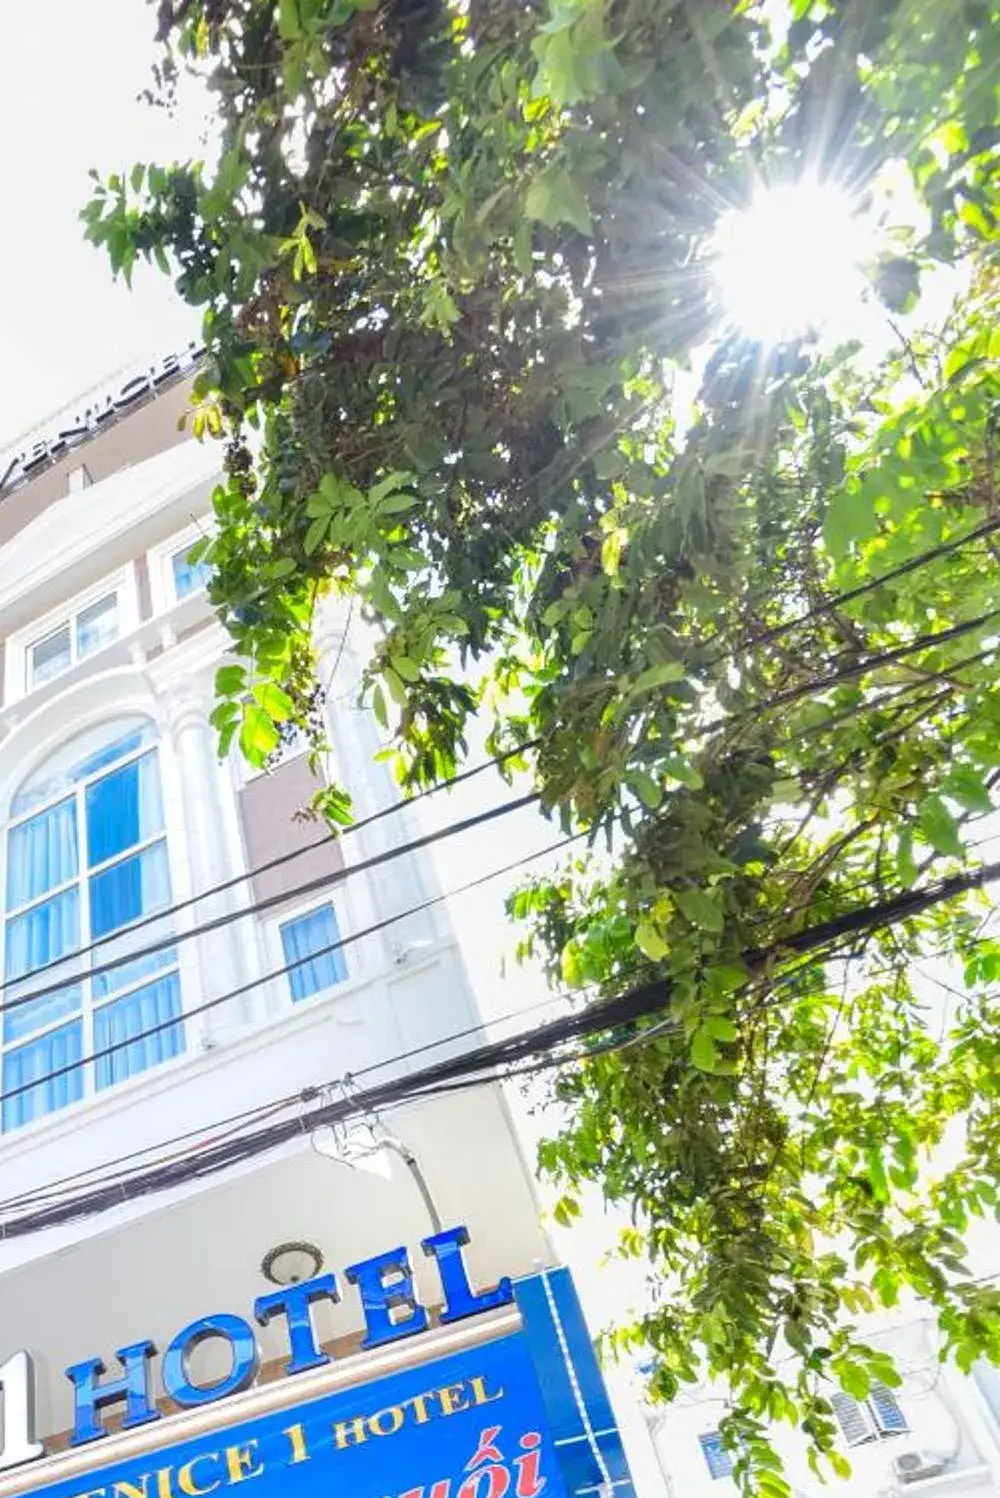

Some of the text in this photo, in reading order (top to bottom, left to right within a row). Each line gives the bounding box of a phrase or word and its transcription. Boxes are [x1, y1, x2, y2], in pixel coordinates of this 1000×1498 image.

[63, 1225, 513, 1447] HOTEL
[283, 1423, 310, 1465] 1
[332, 1375, 505, 1450] HOTEL
